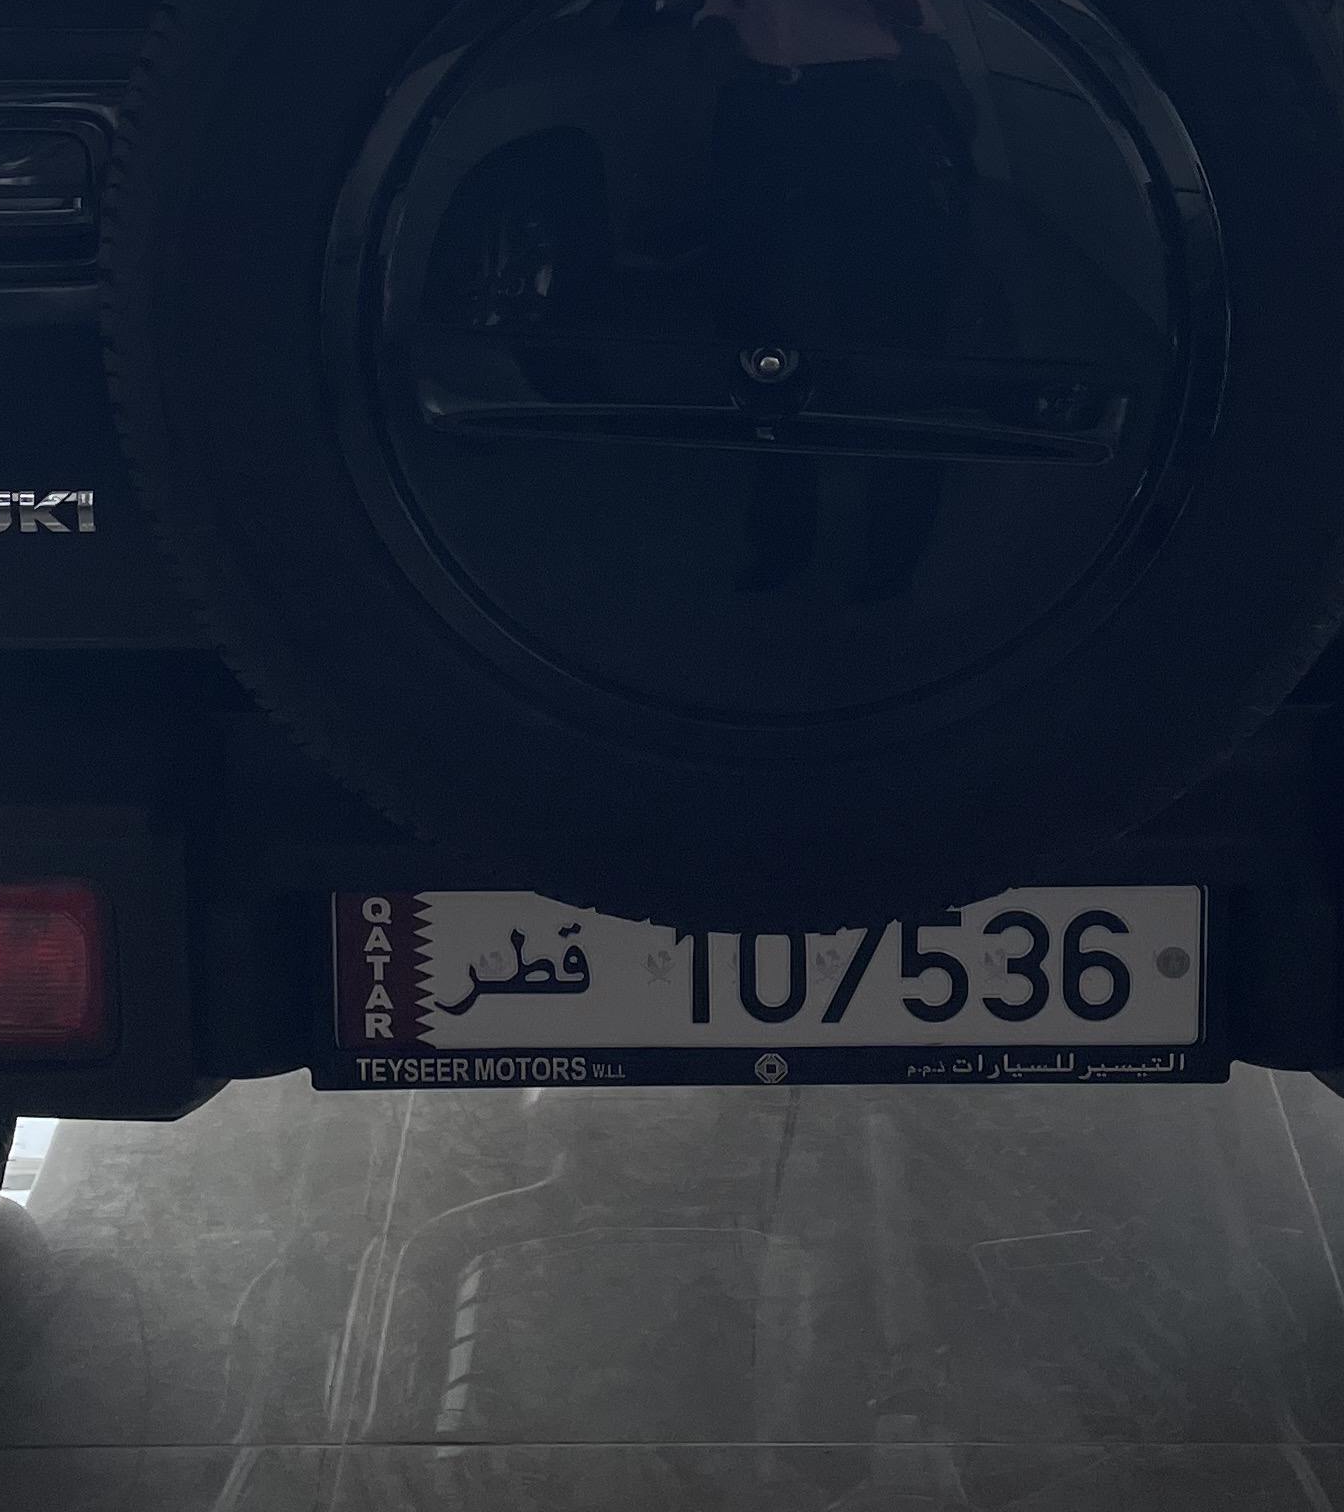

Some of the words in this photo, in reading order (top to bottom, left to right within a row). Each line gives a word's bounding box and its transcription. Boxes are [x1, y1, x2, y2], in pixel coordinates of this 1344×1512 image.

[361, 896, 396, 1040] QATAR
[433, 922, 594, 1016] قطر
[356, 1058, 470, 1082] TEYSEER
[474, 1057, 588, 1082] MOTORS
[952, 1053, 1075, 1079] للسيارات
[1078, 1052, 1186, 1080] التيسير
